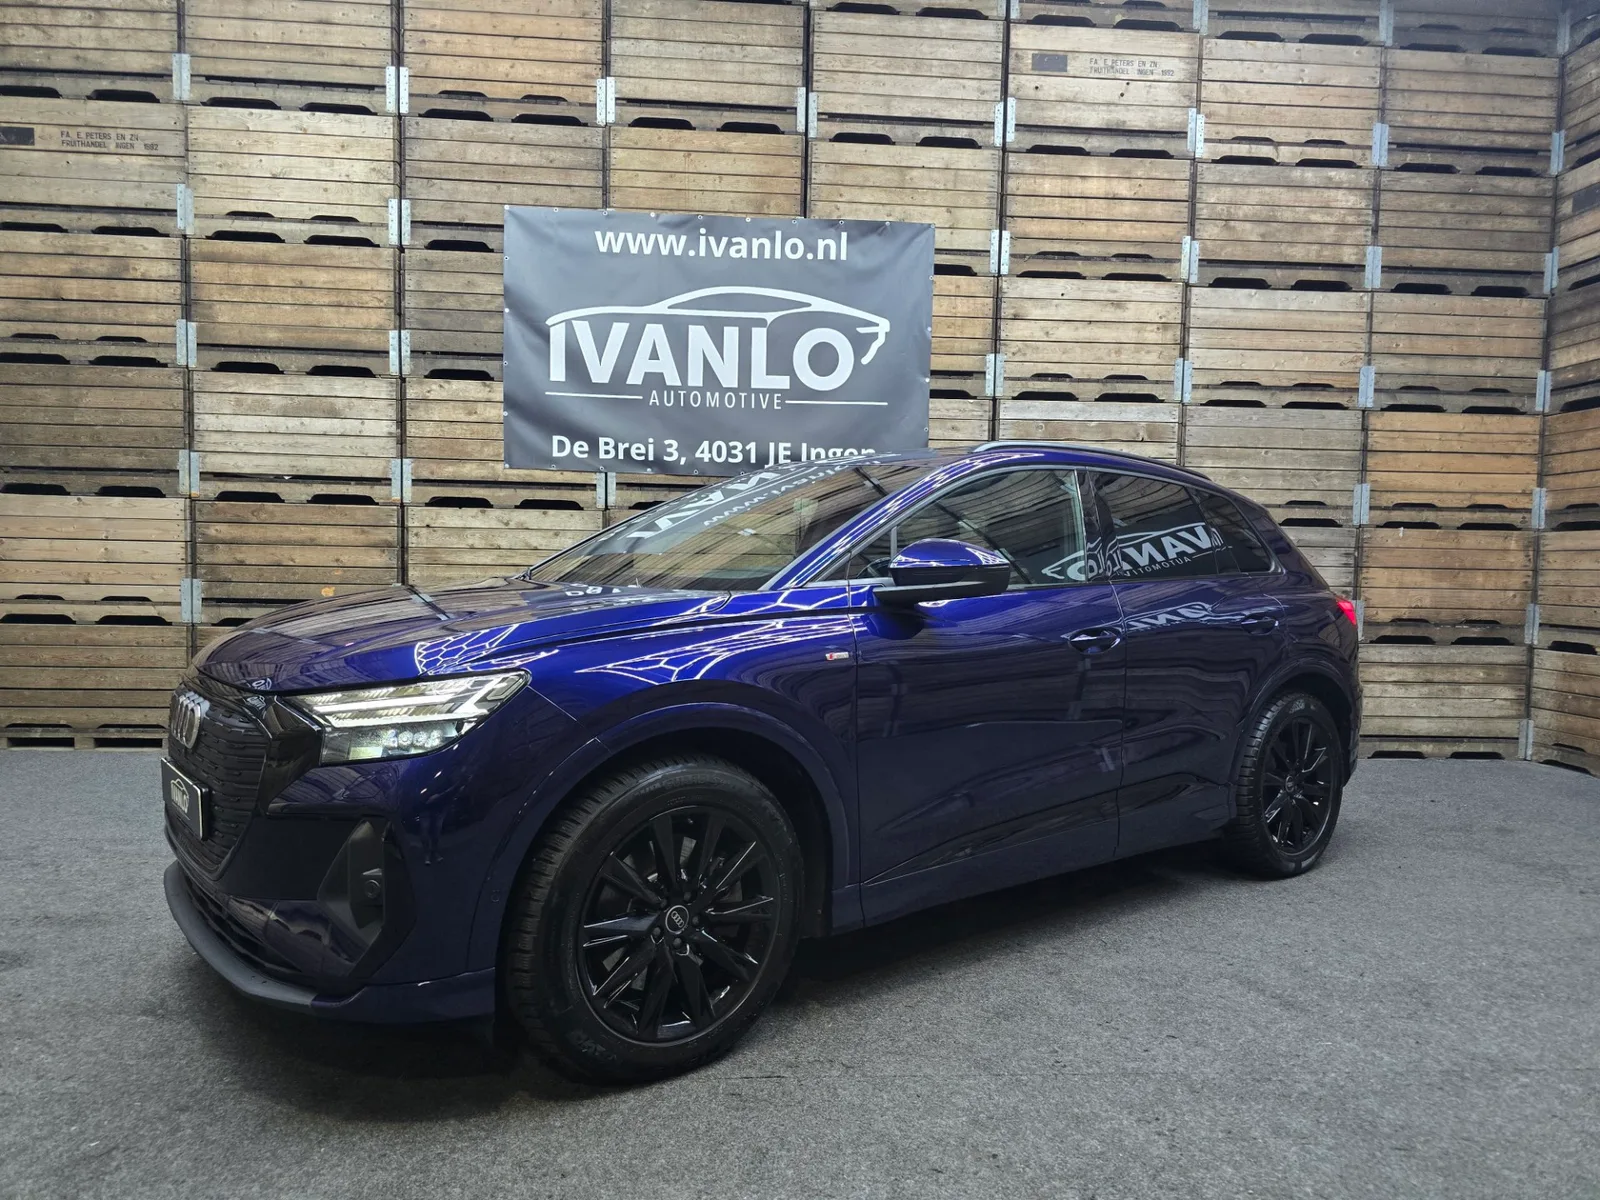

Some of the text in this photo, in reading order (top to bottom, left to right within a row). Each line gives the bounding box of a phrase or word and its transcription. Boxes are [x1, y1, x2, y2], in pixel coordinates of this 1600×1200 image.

[61, 139, 108, 149] FRUITHANDEL
[115, 142, 135, 150] INGEN
[85, 132, 112, 140] PETERS
[116, 133, 126, 141] EN
[594, 227, 848, 261] www.ivanlo.nl
[548, 319, 856, 392] IVANLO
[648, 389, 782, 411] AUTOMOTIVE
[551, 435, 589, 458] De
[598, 436, 655, 461] Brei
[663, 439, 687, 465] 3,
[694, 440, 757, 464] 4031
[764, 442, 792, 469] JE
